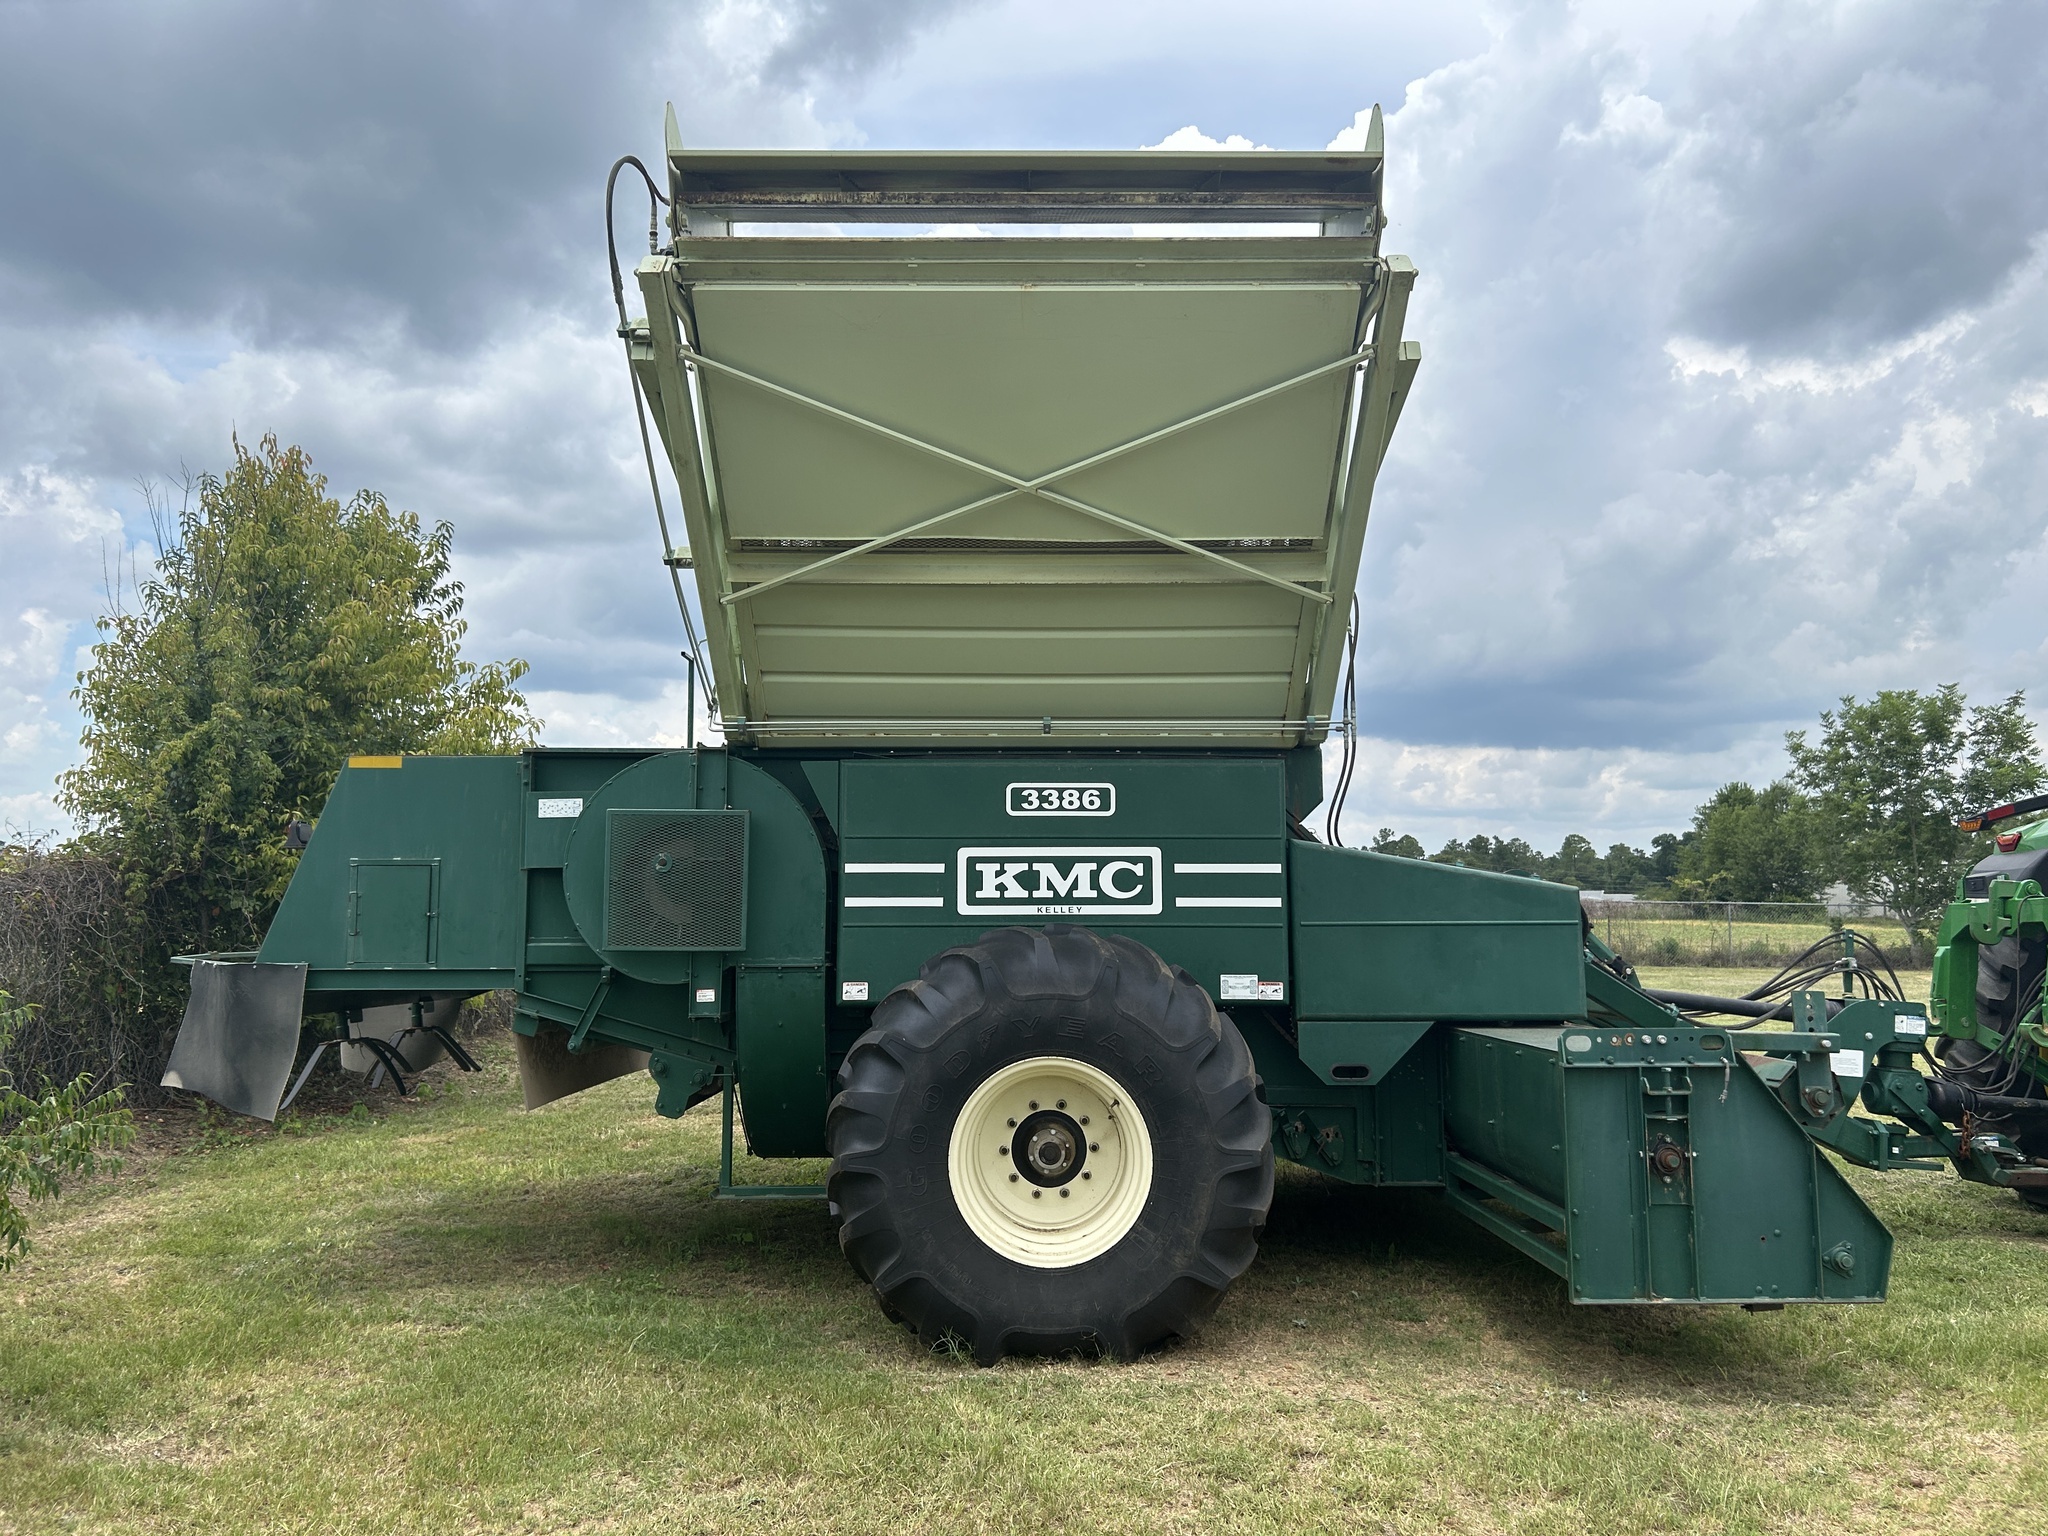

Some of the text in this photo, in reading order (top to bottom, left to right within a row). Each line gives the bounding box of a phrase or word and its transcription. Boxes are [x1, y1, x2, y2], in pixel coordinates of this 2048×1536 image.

[1020, 789, 1101, 810] 3386
[975, 861, 1144, 899] KMC
[1037, 906, 1083, 914] KELLEY
[907, 1015, 1164, 1196] GOODYEAR
